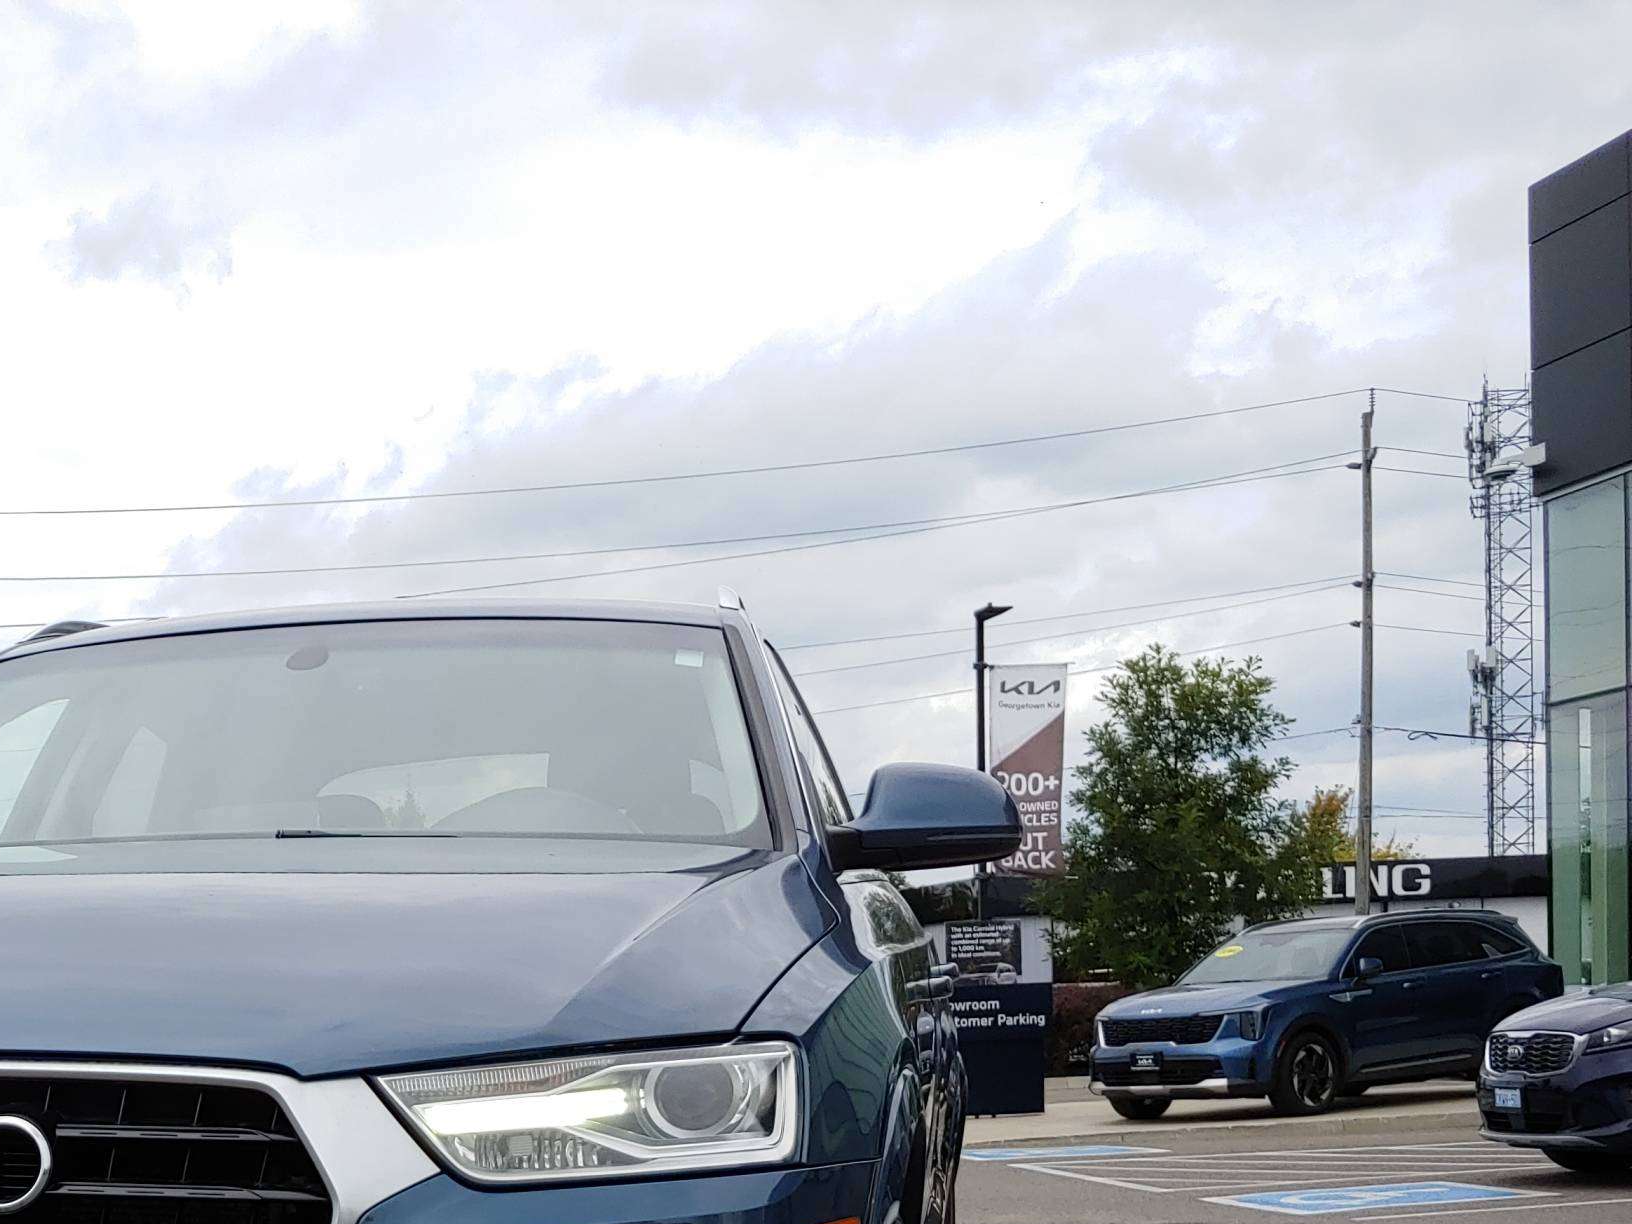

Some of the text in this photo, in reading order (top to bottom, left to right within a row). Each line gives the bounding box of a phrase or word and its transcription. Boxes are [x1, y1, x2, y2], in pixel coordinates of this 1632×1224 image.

[1000, 680, 1060, 695] KIA
[998, 700, 1060, 710] Georgetown Kia
[1019, 801, 1058, 811] OWNED
[1019, 832, 1048, 850] UT
[1320, 864, 1431, 899] LING
[954, 1013, 1046, 1027] tomer Parking
